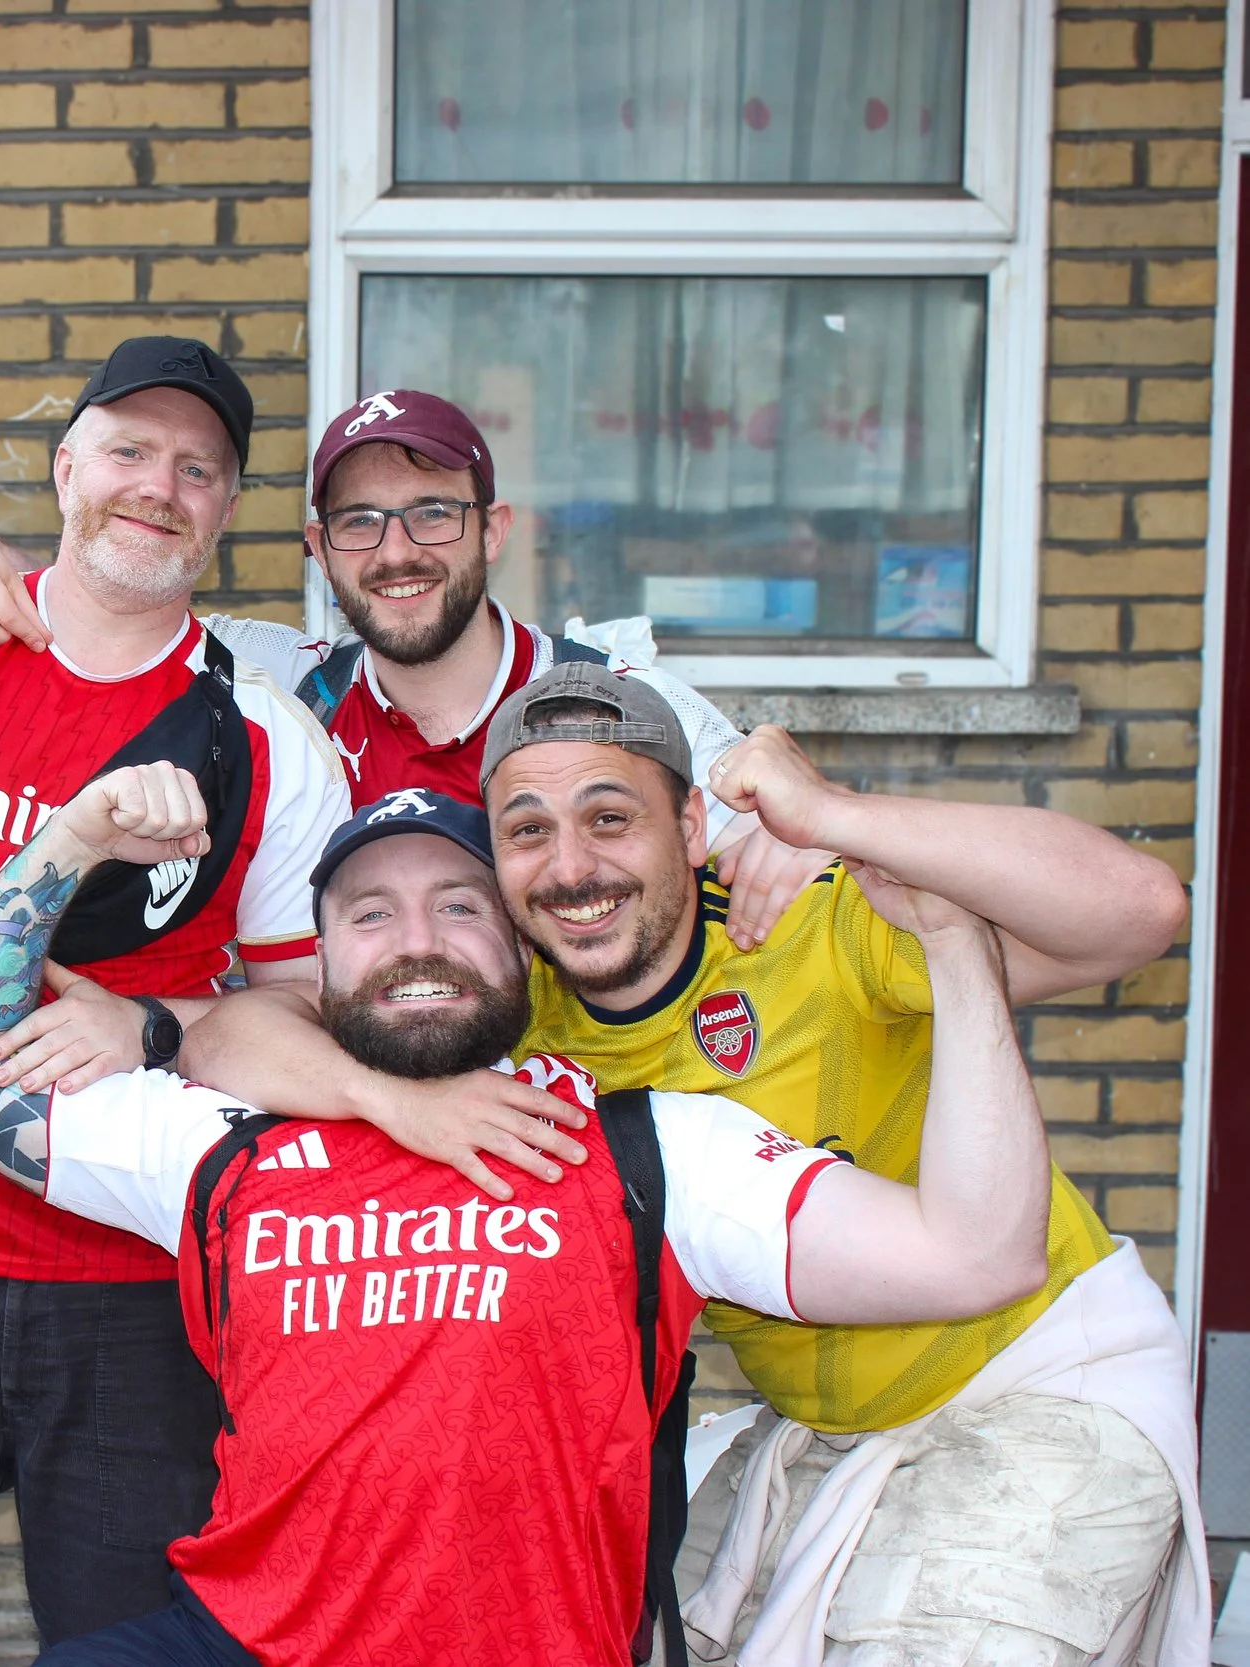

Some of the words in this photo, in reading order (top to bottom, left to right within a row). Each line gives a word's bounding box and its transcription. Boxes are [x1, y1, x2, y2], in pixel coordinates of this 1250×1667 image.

[554, 679, 592, 687] YORK
[596, 685, 623, 702] CITY
[147, 857, 196, 905] NIK
[700, 1004, 745, 1028] Arsenal
[244, 1195, 561, 1275] Emirates
[282, 1273, 347, 1336] FLY
[360, 1263, 508, 1327] BETTER
